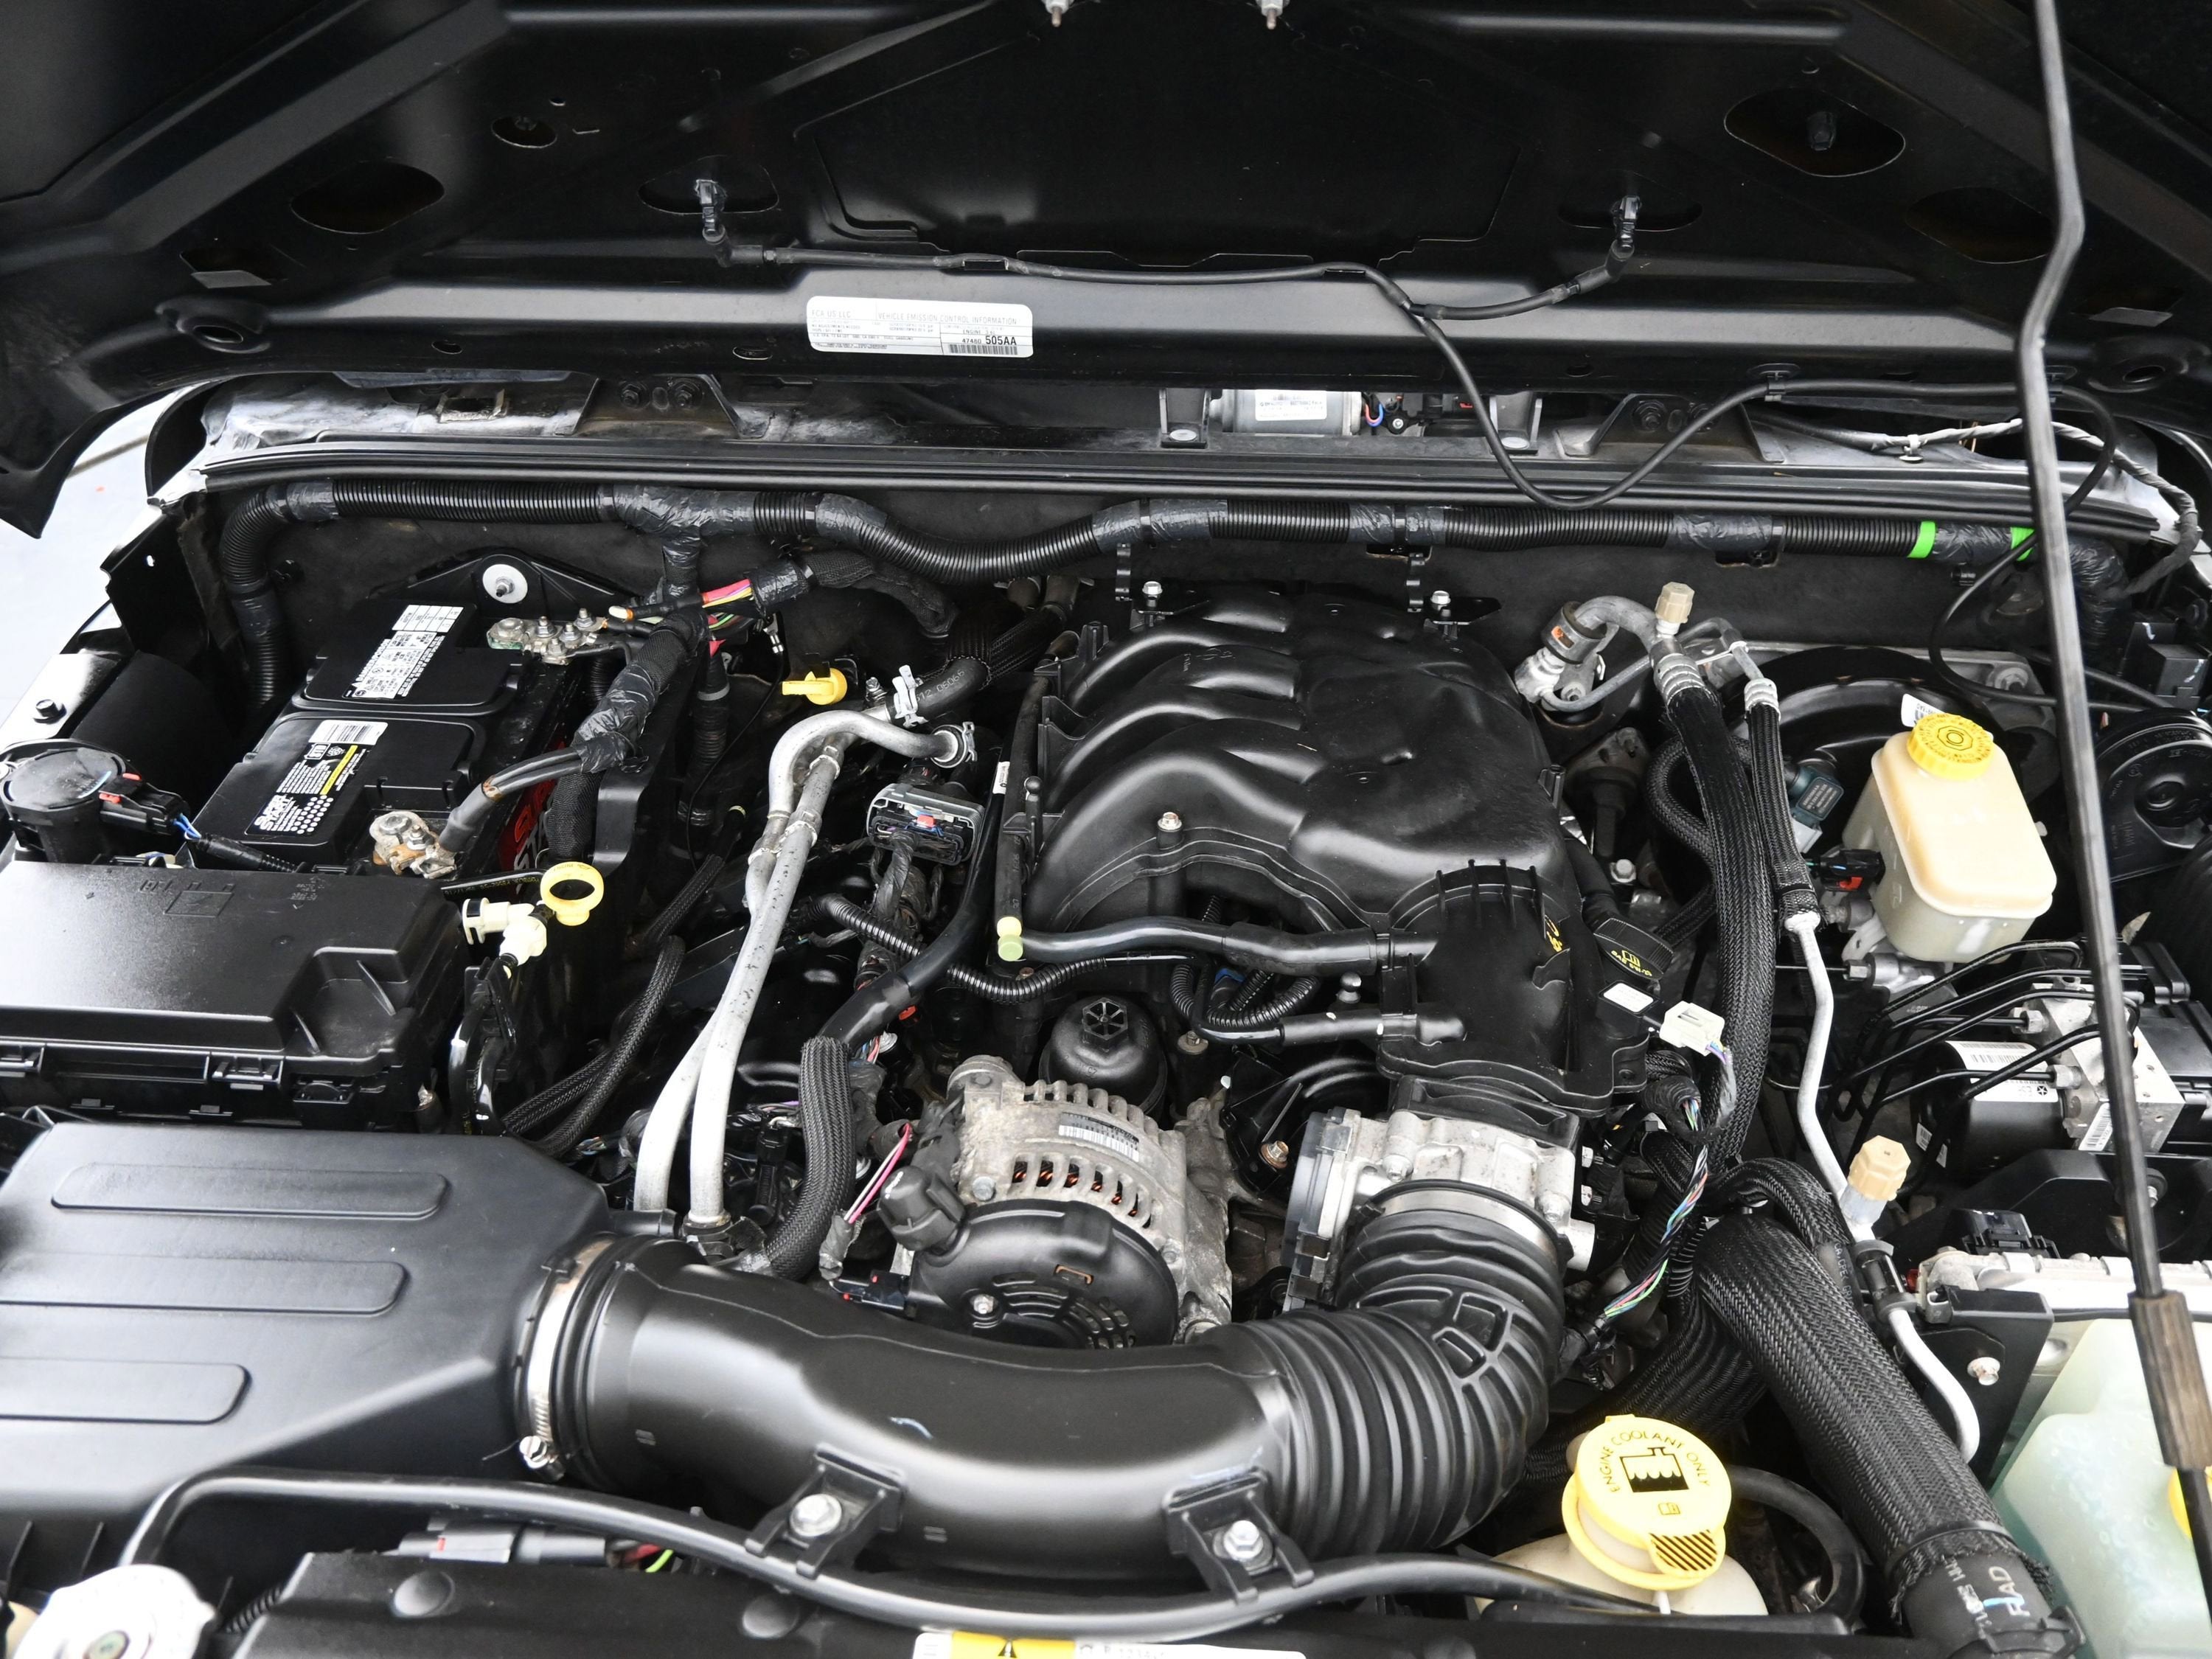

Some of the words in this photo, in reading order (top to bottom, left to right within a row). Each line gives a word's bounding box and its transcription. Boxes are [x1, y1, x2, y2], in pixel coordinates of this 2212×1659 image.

[811, 309, 824, 317] FCA
[838, 310, 851, 319] LLC
[878, 312, 903, 321] VEHICLE
[906, 313, 937, 322] EMISSION
[940, 315, 969, 323] CONTROL
[972, 316, 1017, 324] INFORMATION
[985, 335, 1018, 345] 505AA
[1599, 1445, 1621, 1493] ENGINE
[1610, 1430, 1685, 1449] COOLANT
[1686, 1452, 1711, 1486] ONLY
